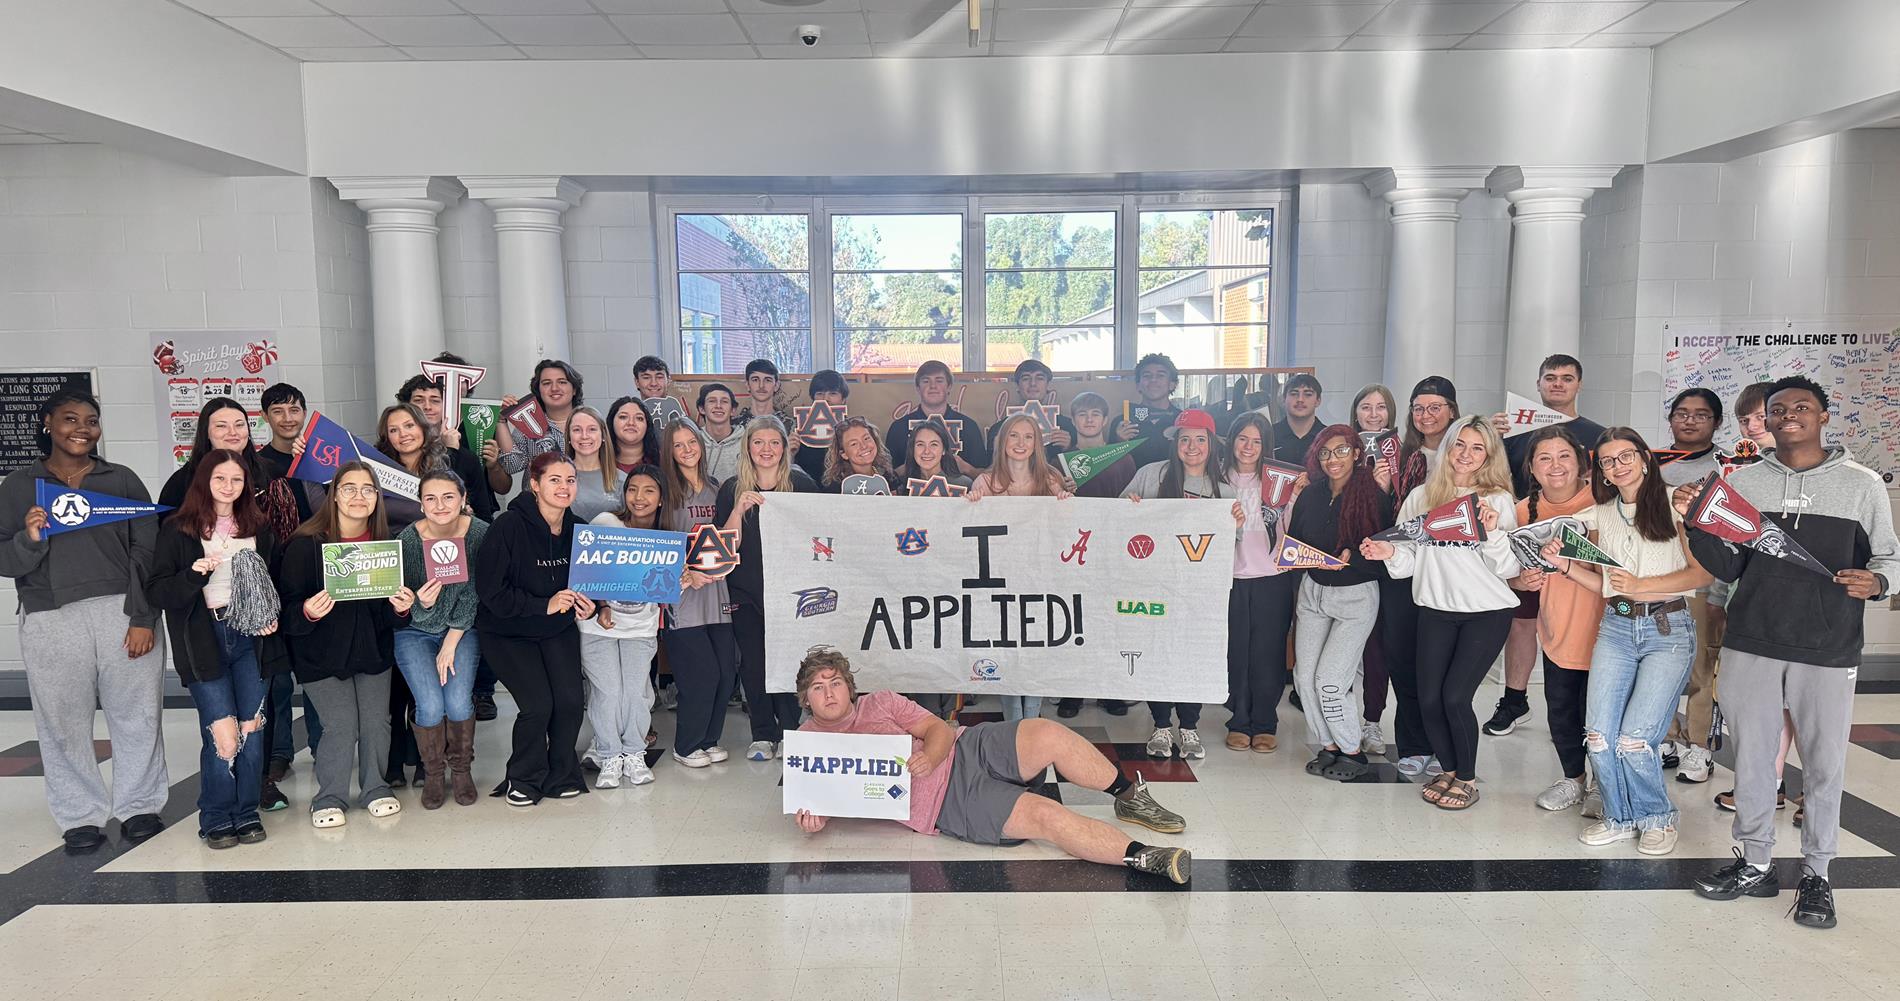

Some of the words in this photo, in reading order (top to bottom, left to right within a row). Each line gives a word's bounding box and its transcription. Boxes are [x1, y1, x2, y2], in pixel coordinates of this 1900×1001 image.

[1675, 336, 1679, 347] I
[1683, 335, 1732, 347] ACCEPT
[1736, 335, 1760, 346] THE
[1765, 334, 1837, 346] CHALLENGE
[1841, 333, 1858, 345] TO
[1862, 333, 1890, 344] LIVE
[181, 346, 217, 366] Spirit
[203, 360, 229, 373] 2025
[10, 385, 29, 394] LONG
[420, 360, 487, 431] T
[18, 413, 27, 422] OF
[650, 402, 663, 416] A
[509, 400, 544, 438] T
[1266, 467, 1299, 507] T
[1427, 500, 1475, 537] T
[1697, 485, 1757, 533] T
[628, 536, 656, 544] AVIATION
[656, 538, 682, 546] COLLEGE
[1060, 528, 1092, 566] A
[1130, 540, 1152, 559] W
[1176, 533, 1216, 563] V
[433, 545, 455, 564] W
[536, 557, 568, 567] LATINX
[576, 549, 615, 565] AAC
[616, 550, 679, 565] BOUND
[961, 525, 1008, 589] I
[1297, 544, 1325, 561] NORTH
[1576, 547, 1597, 563] STATE
[355, 556, 398, 572] BOUND
[572, 581, 639, 593] #AIMHIGHER
[1117, 601, 1165, 616] UAB
[861, 594, 1085, 651] APPLIED!
[1119, 651, 1143, 677] T
[1322, 684, 1346, 723] OAHU
[787, 755, 903, 777] #IAPPLIED
